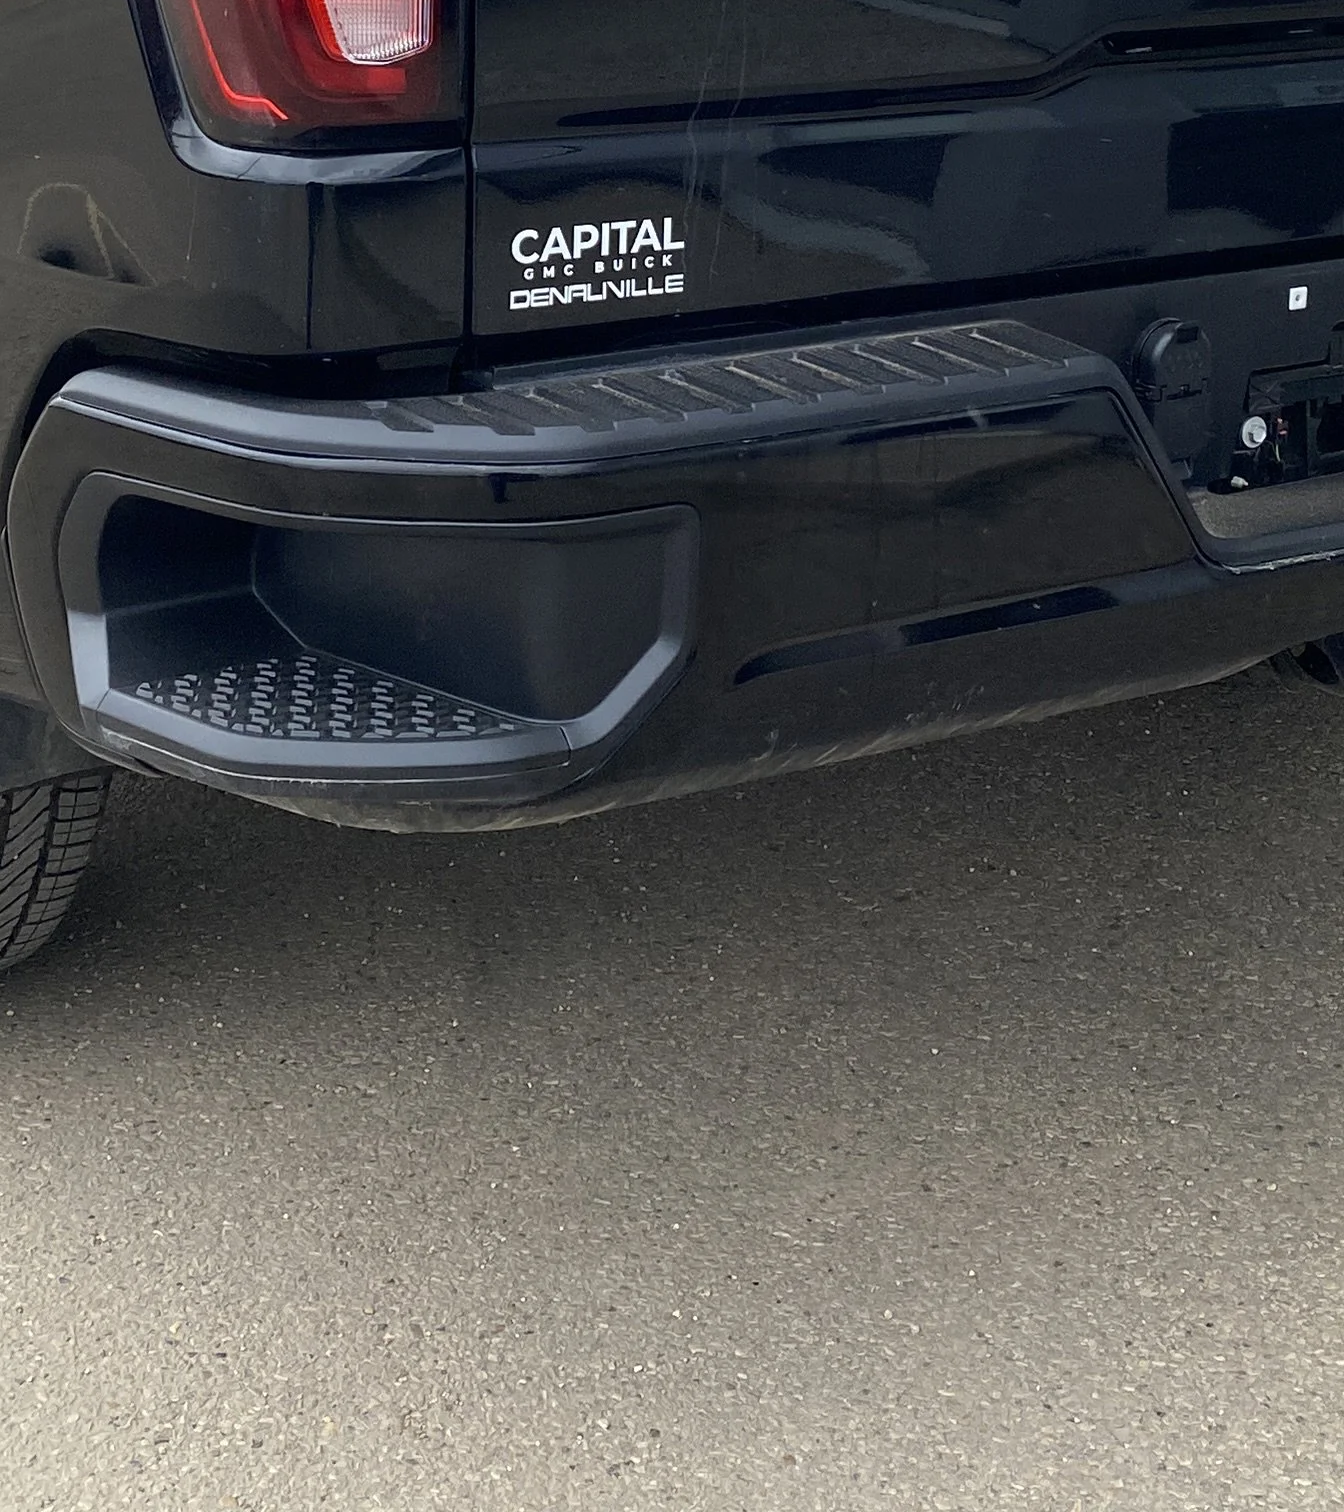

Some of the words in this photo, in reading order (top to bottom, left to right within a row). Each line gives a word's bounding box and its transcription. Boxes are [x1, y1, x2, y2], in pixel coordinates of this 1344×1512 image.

[511, 217, 685, 265] CAPITAL
[523, 264, 574, 280] GMC
[595, 254, 673, 274] BUICK
[509, 273, 684, 310] DENALIVILLE
